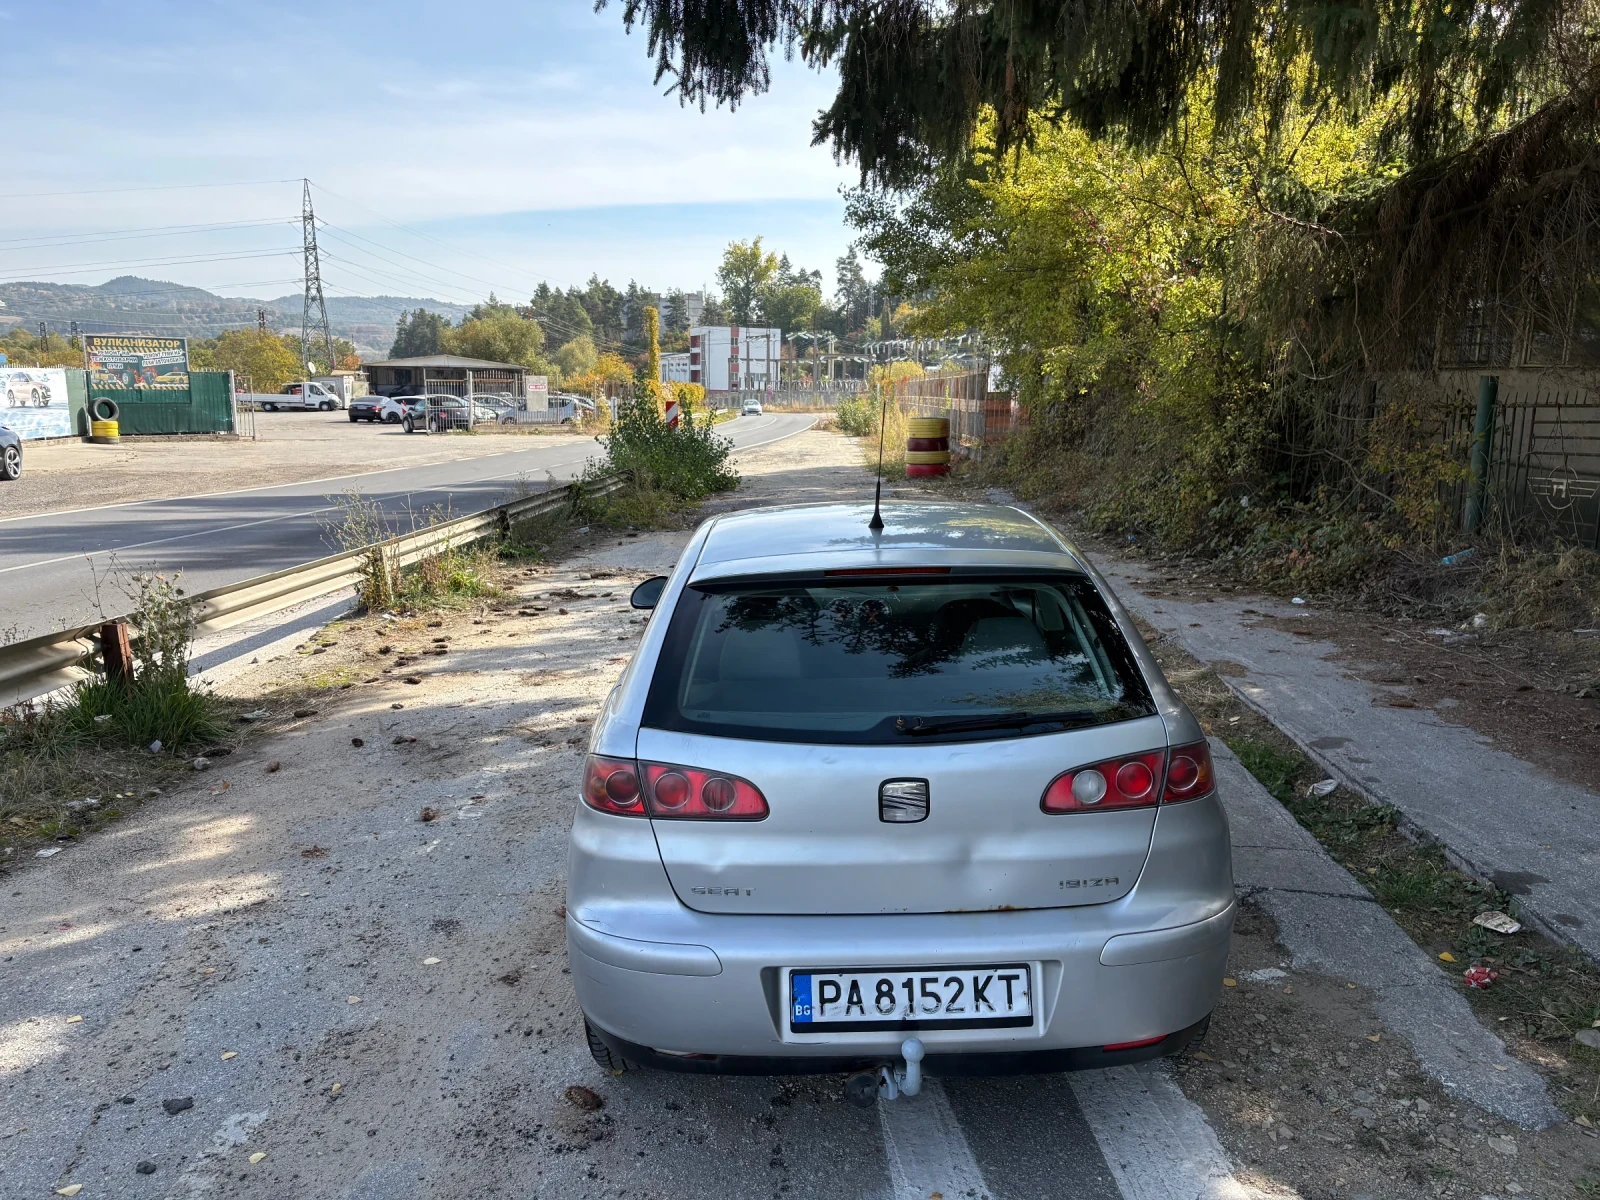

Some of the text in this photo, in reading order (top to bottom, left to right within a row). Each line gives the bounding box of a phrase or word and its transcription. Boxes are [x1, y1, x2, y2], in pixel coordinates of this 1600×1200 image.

[93, 337, 180, 348] ВУЛКАНИЗАТОР
[1059, 877, 1119, 889] IBIZA
[691, 886, 756, 896] SEAT
[795, 1004, 811, 1016] BG
